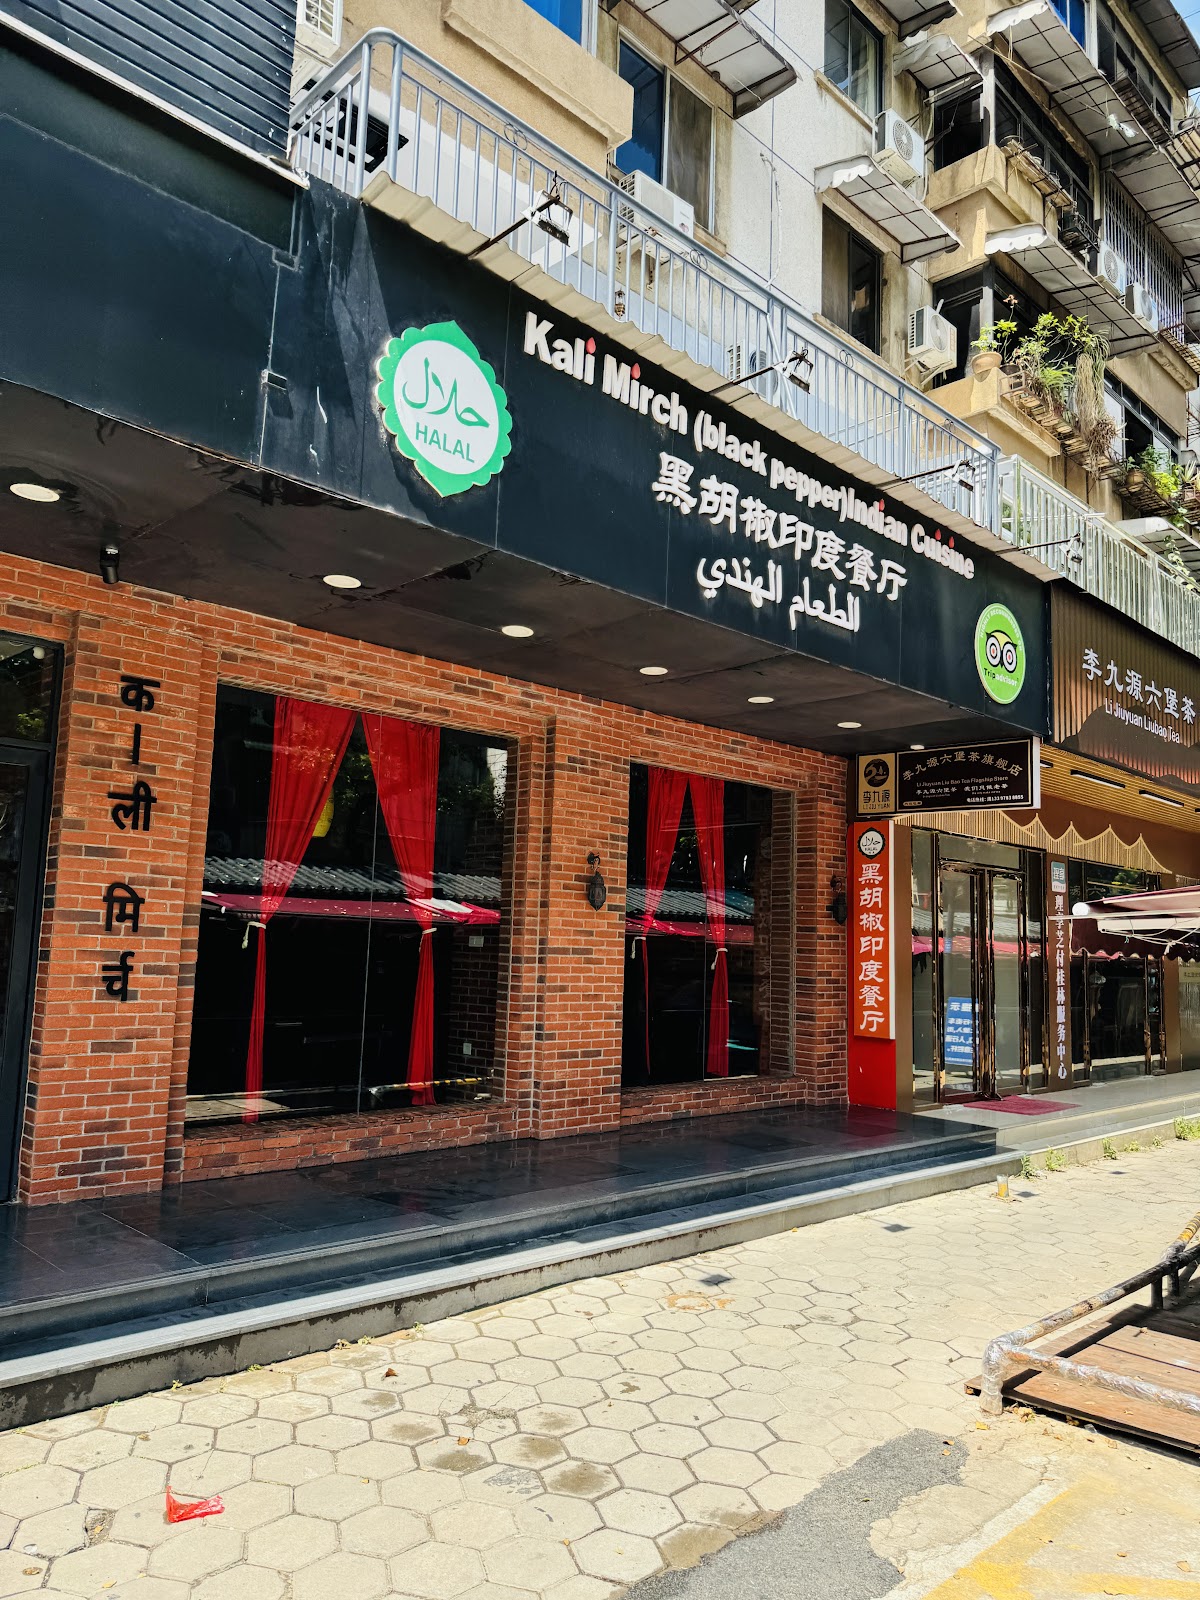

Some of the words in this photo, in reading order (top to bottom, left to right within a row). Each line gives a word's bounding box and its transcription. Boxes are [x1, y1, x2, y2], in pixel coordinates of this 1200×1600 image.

[401, 357, 490, 430] حلال
[415, 422, 476, 464] HALAL
[524, 311, 596, 385] Kali
[602, 353, 688, 435] Mirch
[694, 409, 768, 478] (black
[911, 523, 975, 580] Cuisine
[651, 451, 908, 602] 黑胡椒印度餐厅
[697, 557, 783, 608] الهندي
[789, 577, 860, 632] الطعام
[1082, 648, 1196, 724] 李九源六堡茶
[1104, 698, 1113, 715] Li
[1113, 702, 1143, 725] Jiuyuan
[1144, 715, 1168, 739] Liubao
[1168, 726, 1180, 744] Tea
[902, 751, 1023, 781] 李九源六堡茶旗舰店
[863, 789, 891, 804] 李九源
[858, 863, 885, 1033] 黑胡椒印度餐厅
